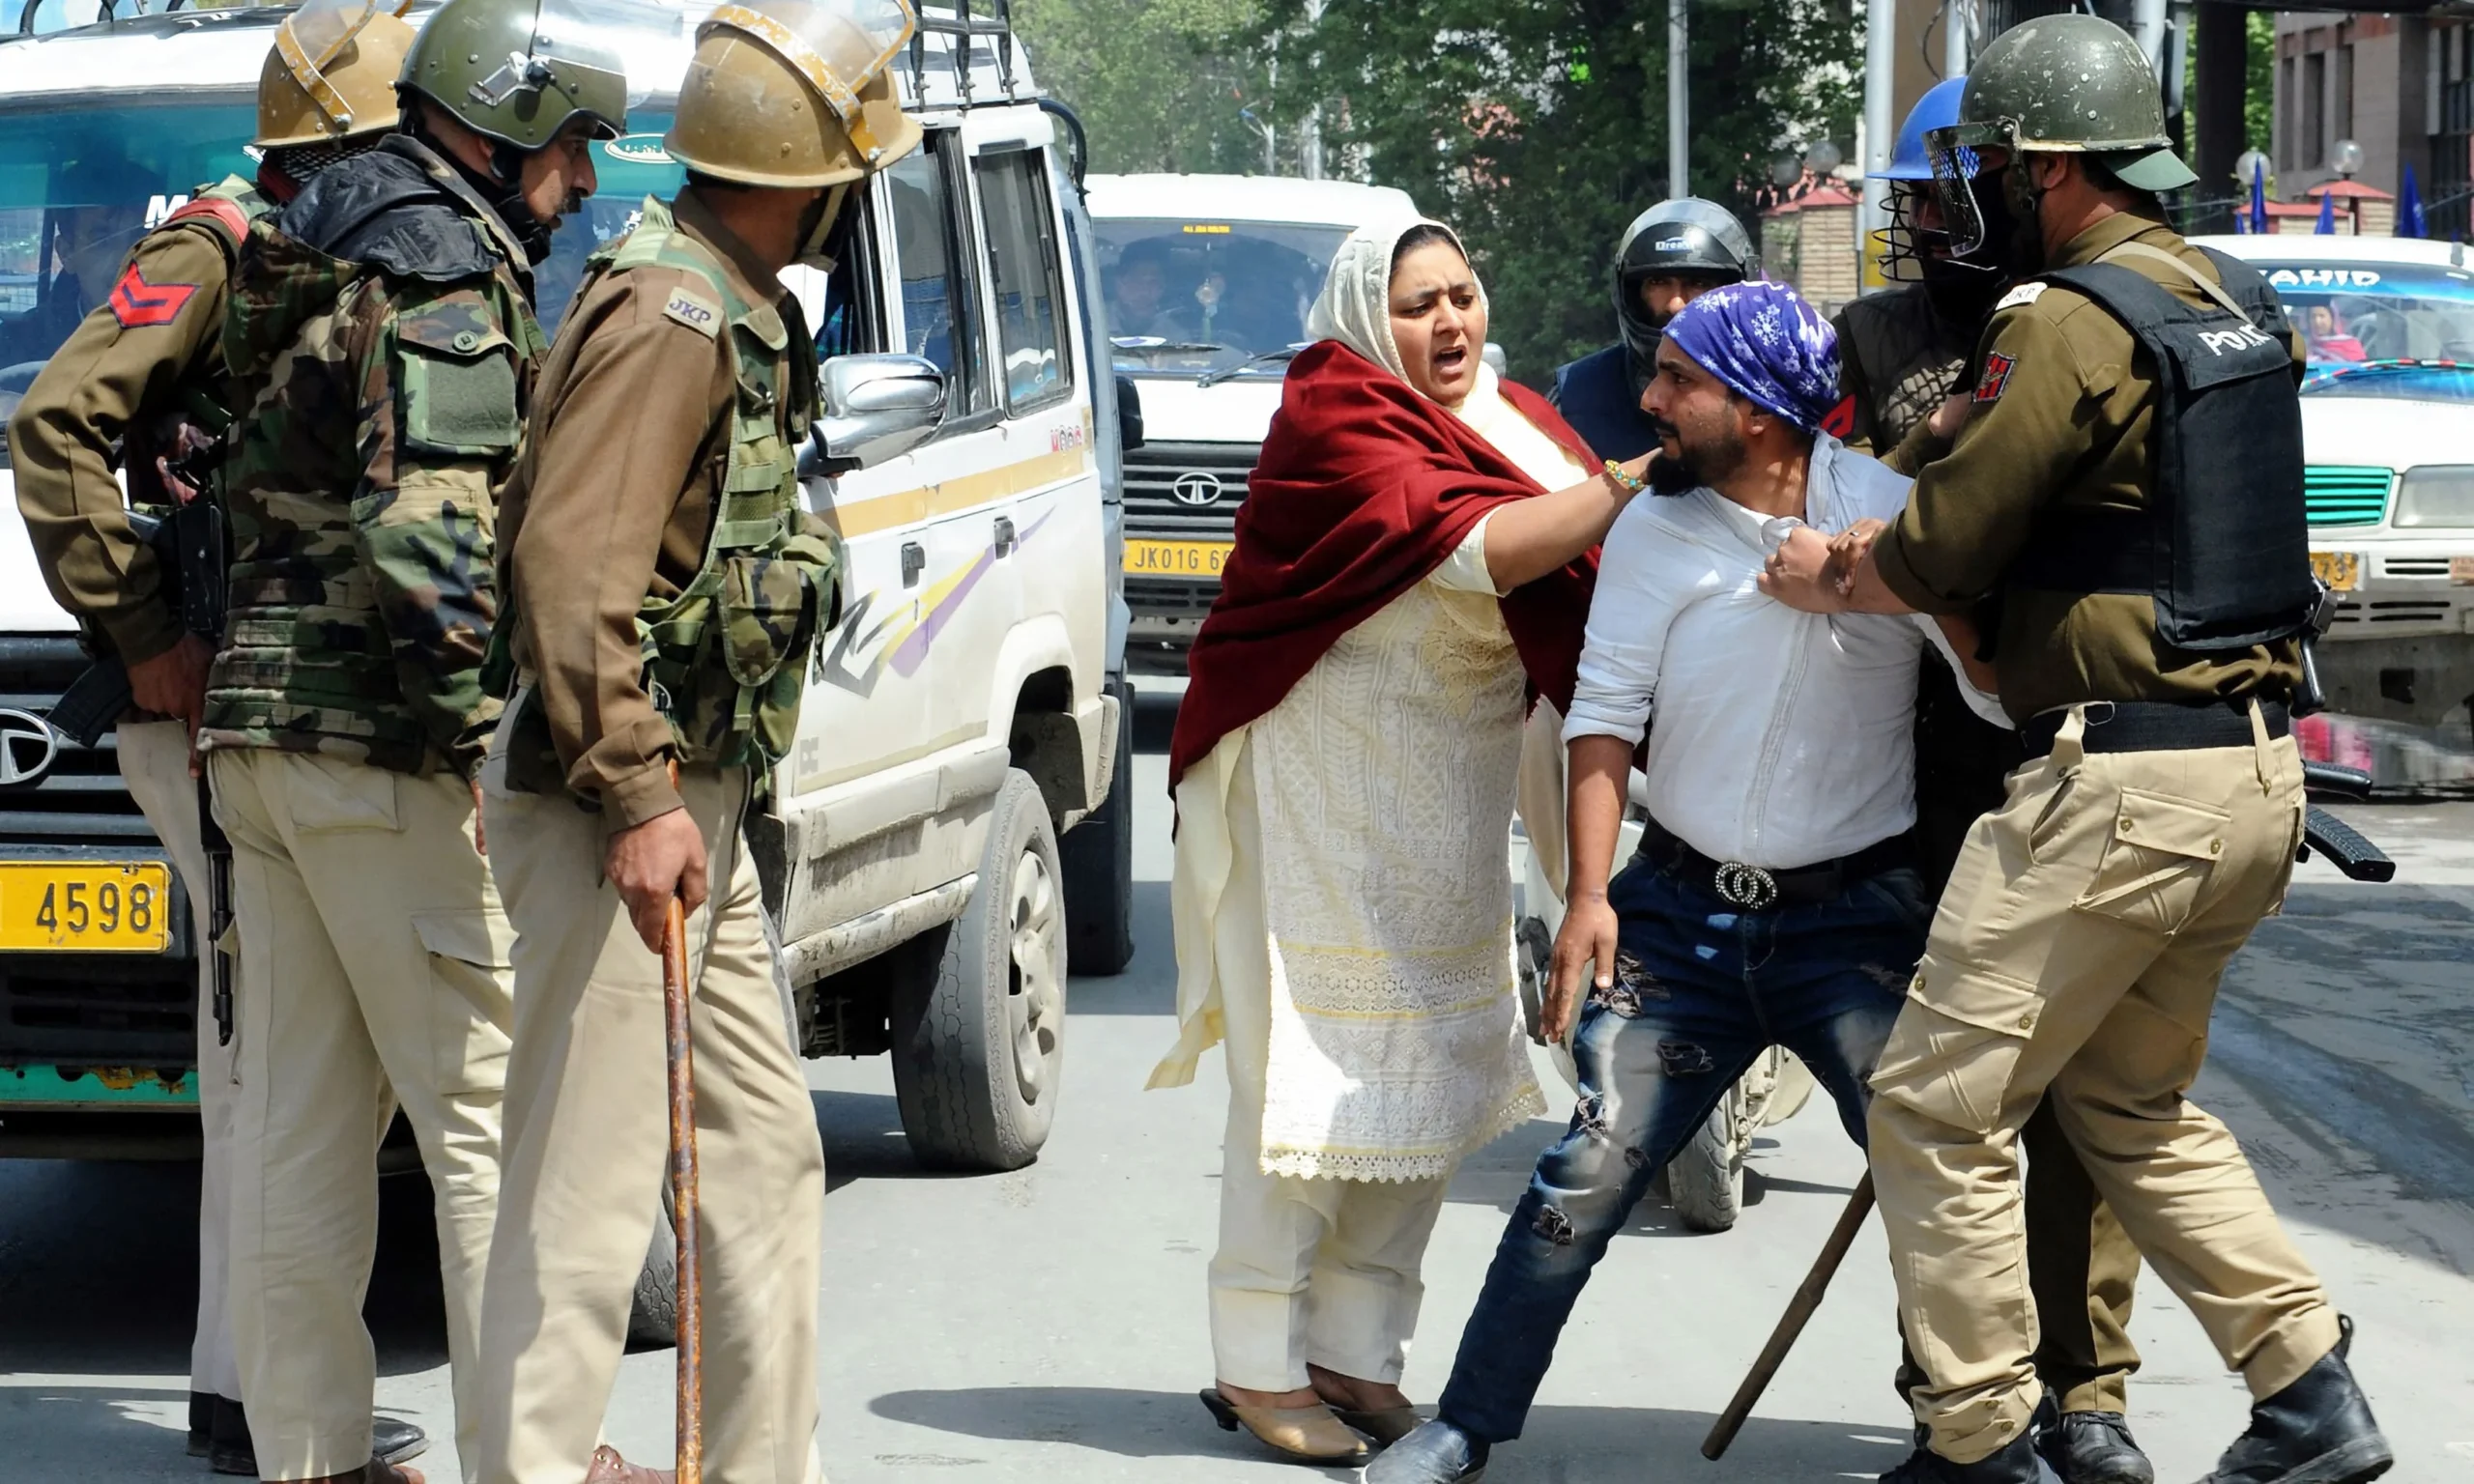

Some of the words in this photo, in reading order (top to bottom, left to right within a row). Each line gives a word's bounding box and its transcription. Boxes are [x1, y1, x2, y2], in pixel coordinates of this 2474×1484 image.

[2258, 269, 2380, 287] AHID
[669, 298, 711, 324] JKP
[1135, 547, 1198, 569] JK01G
[36, 882, 152, 933] 4598
